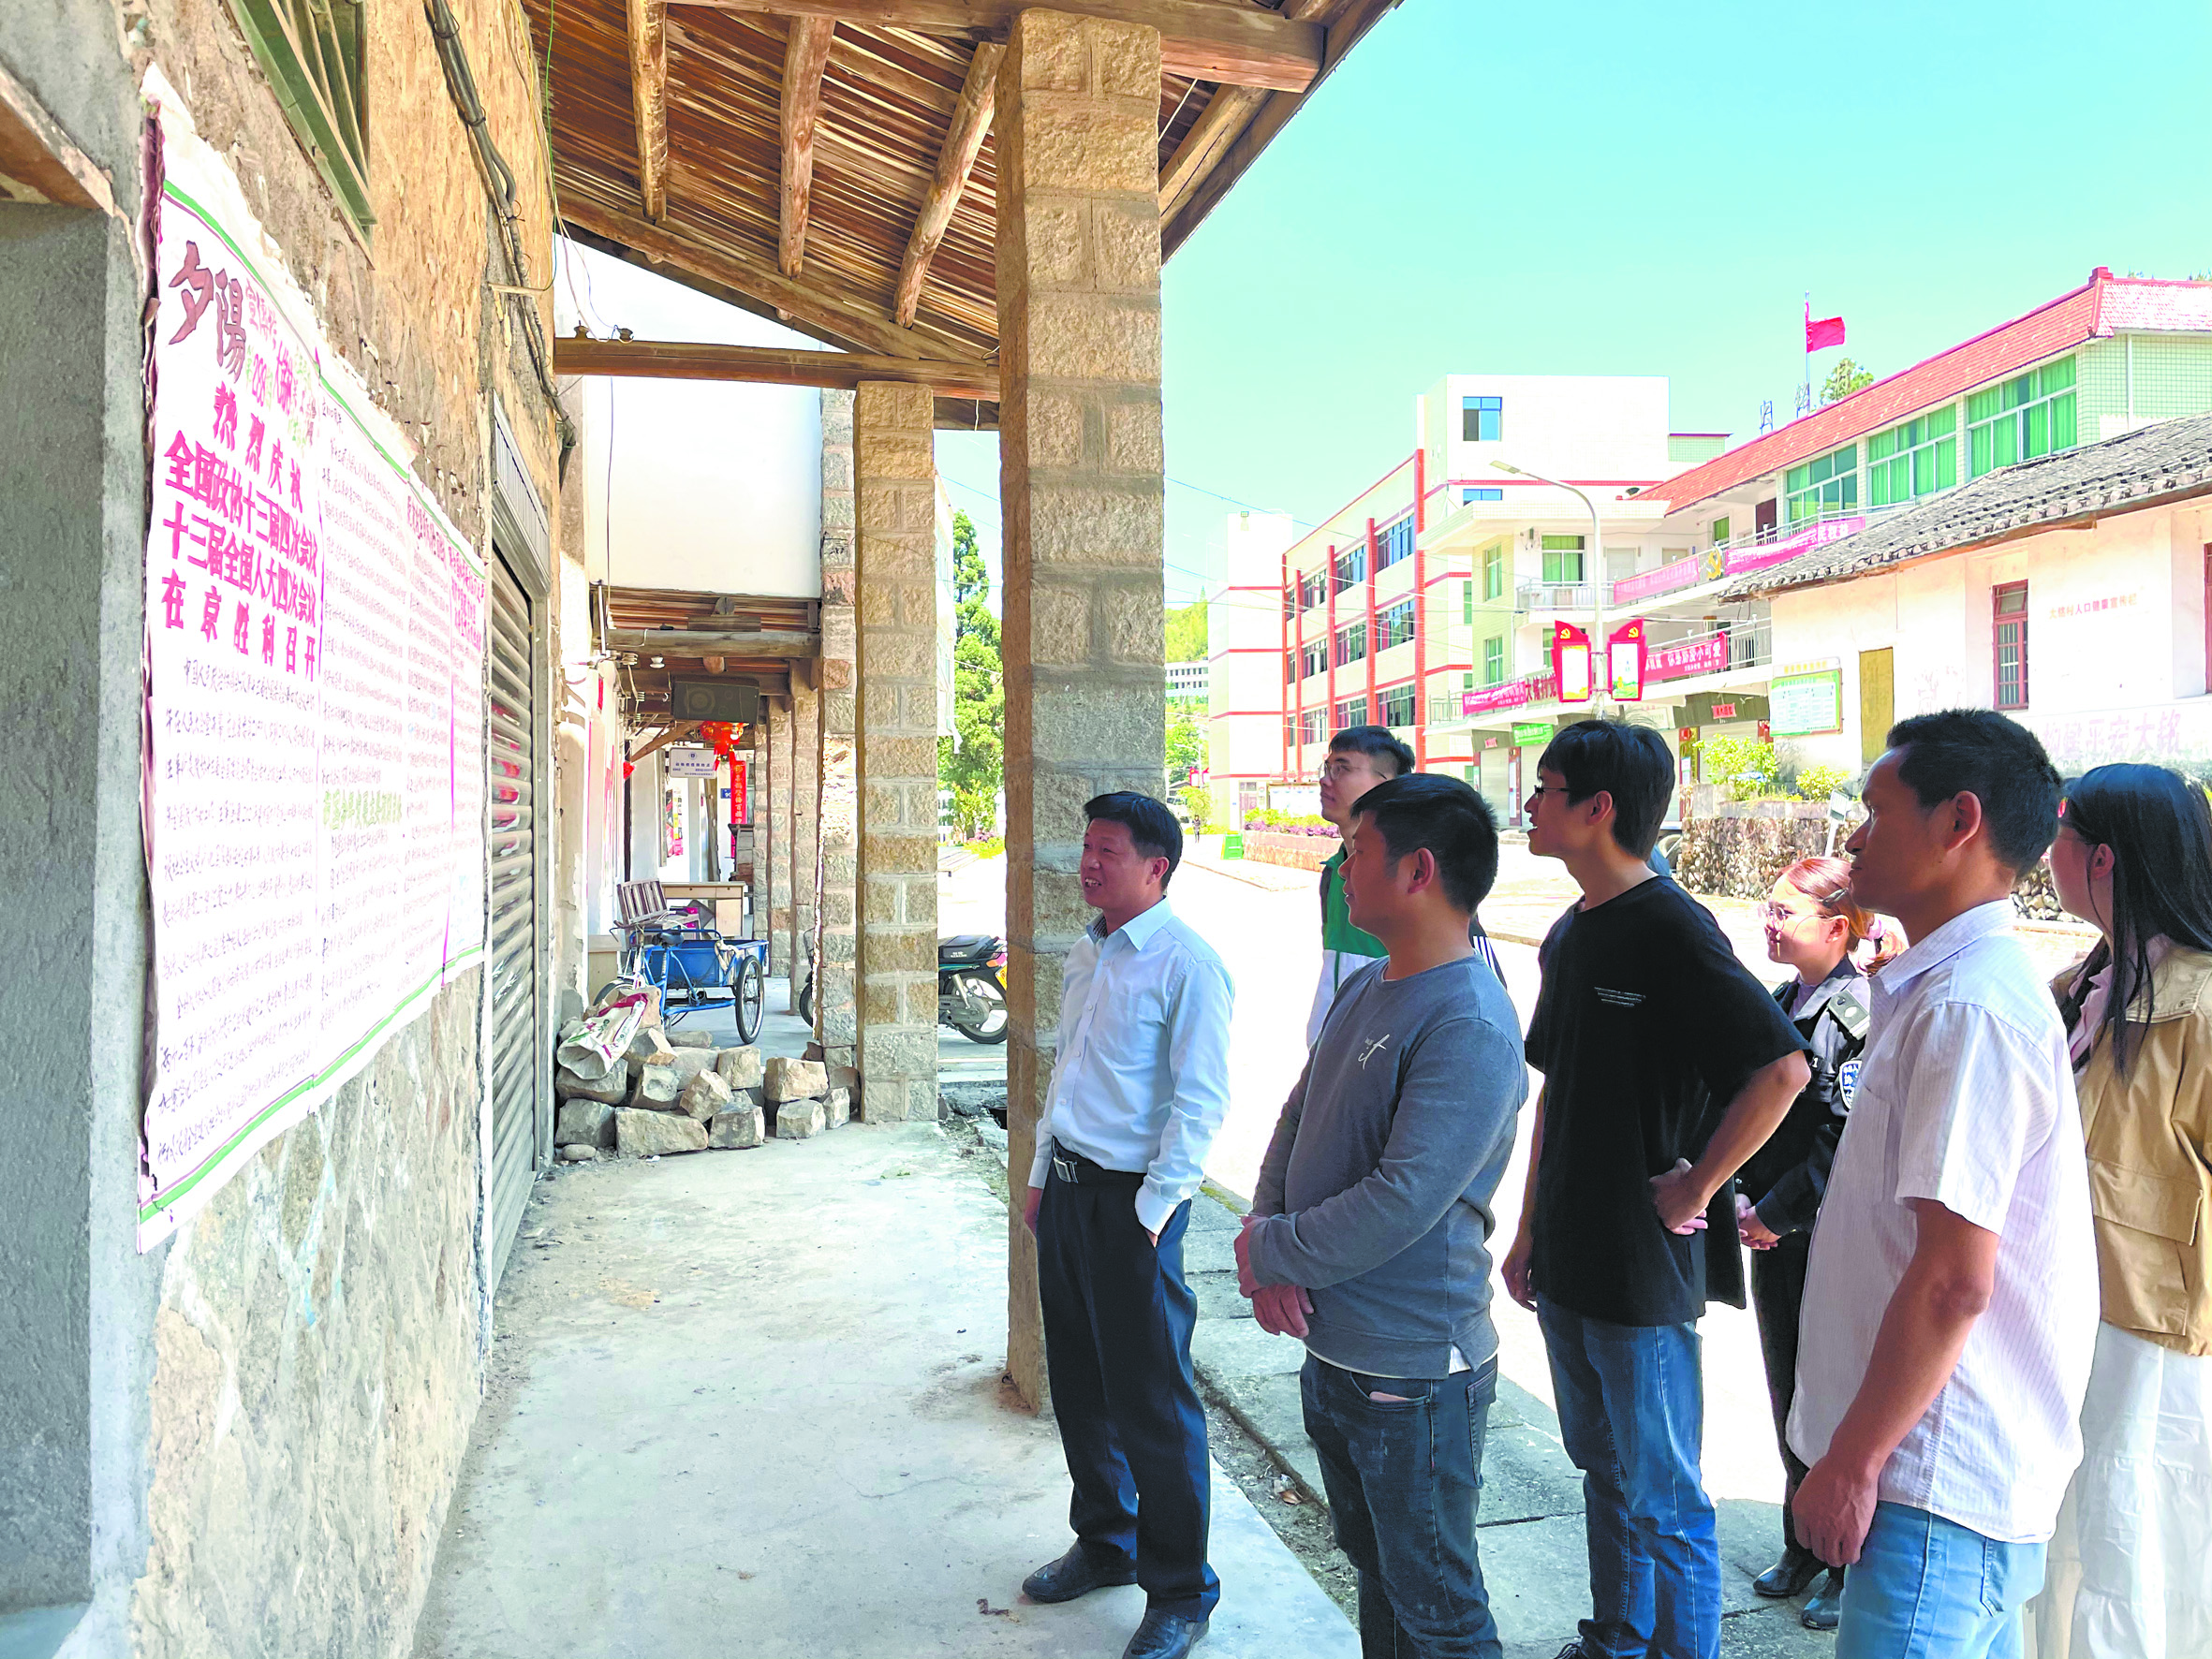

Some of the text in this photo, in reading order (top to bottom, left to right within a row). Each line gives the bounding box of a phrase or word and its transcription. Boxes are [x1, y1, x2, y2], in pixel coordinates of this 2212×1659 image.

[163, 430, 317, 578] 全国政协十三届四次会议
[213, 380, 302, 513] 热烈庆祝
[161, 568, 316, 683] 在京胜利召开
[162, 500, 316, 627] 十三届全国人大四次会议
